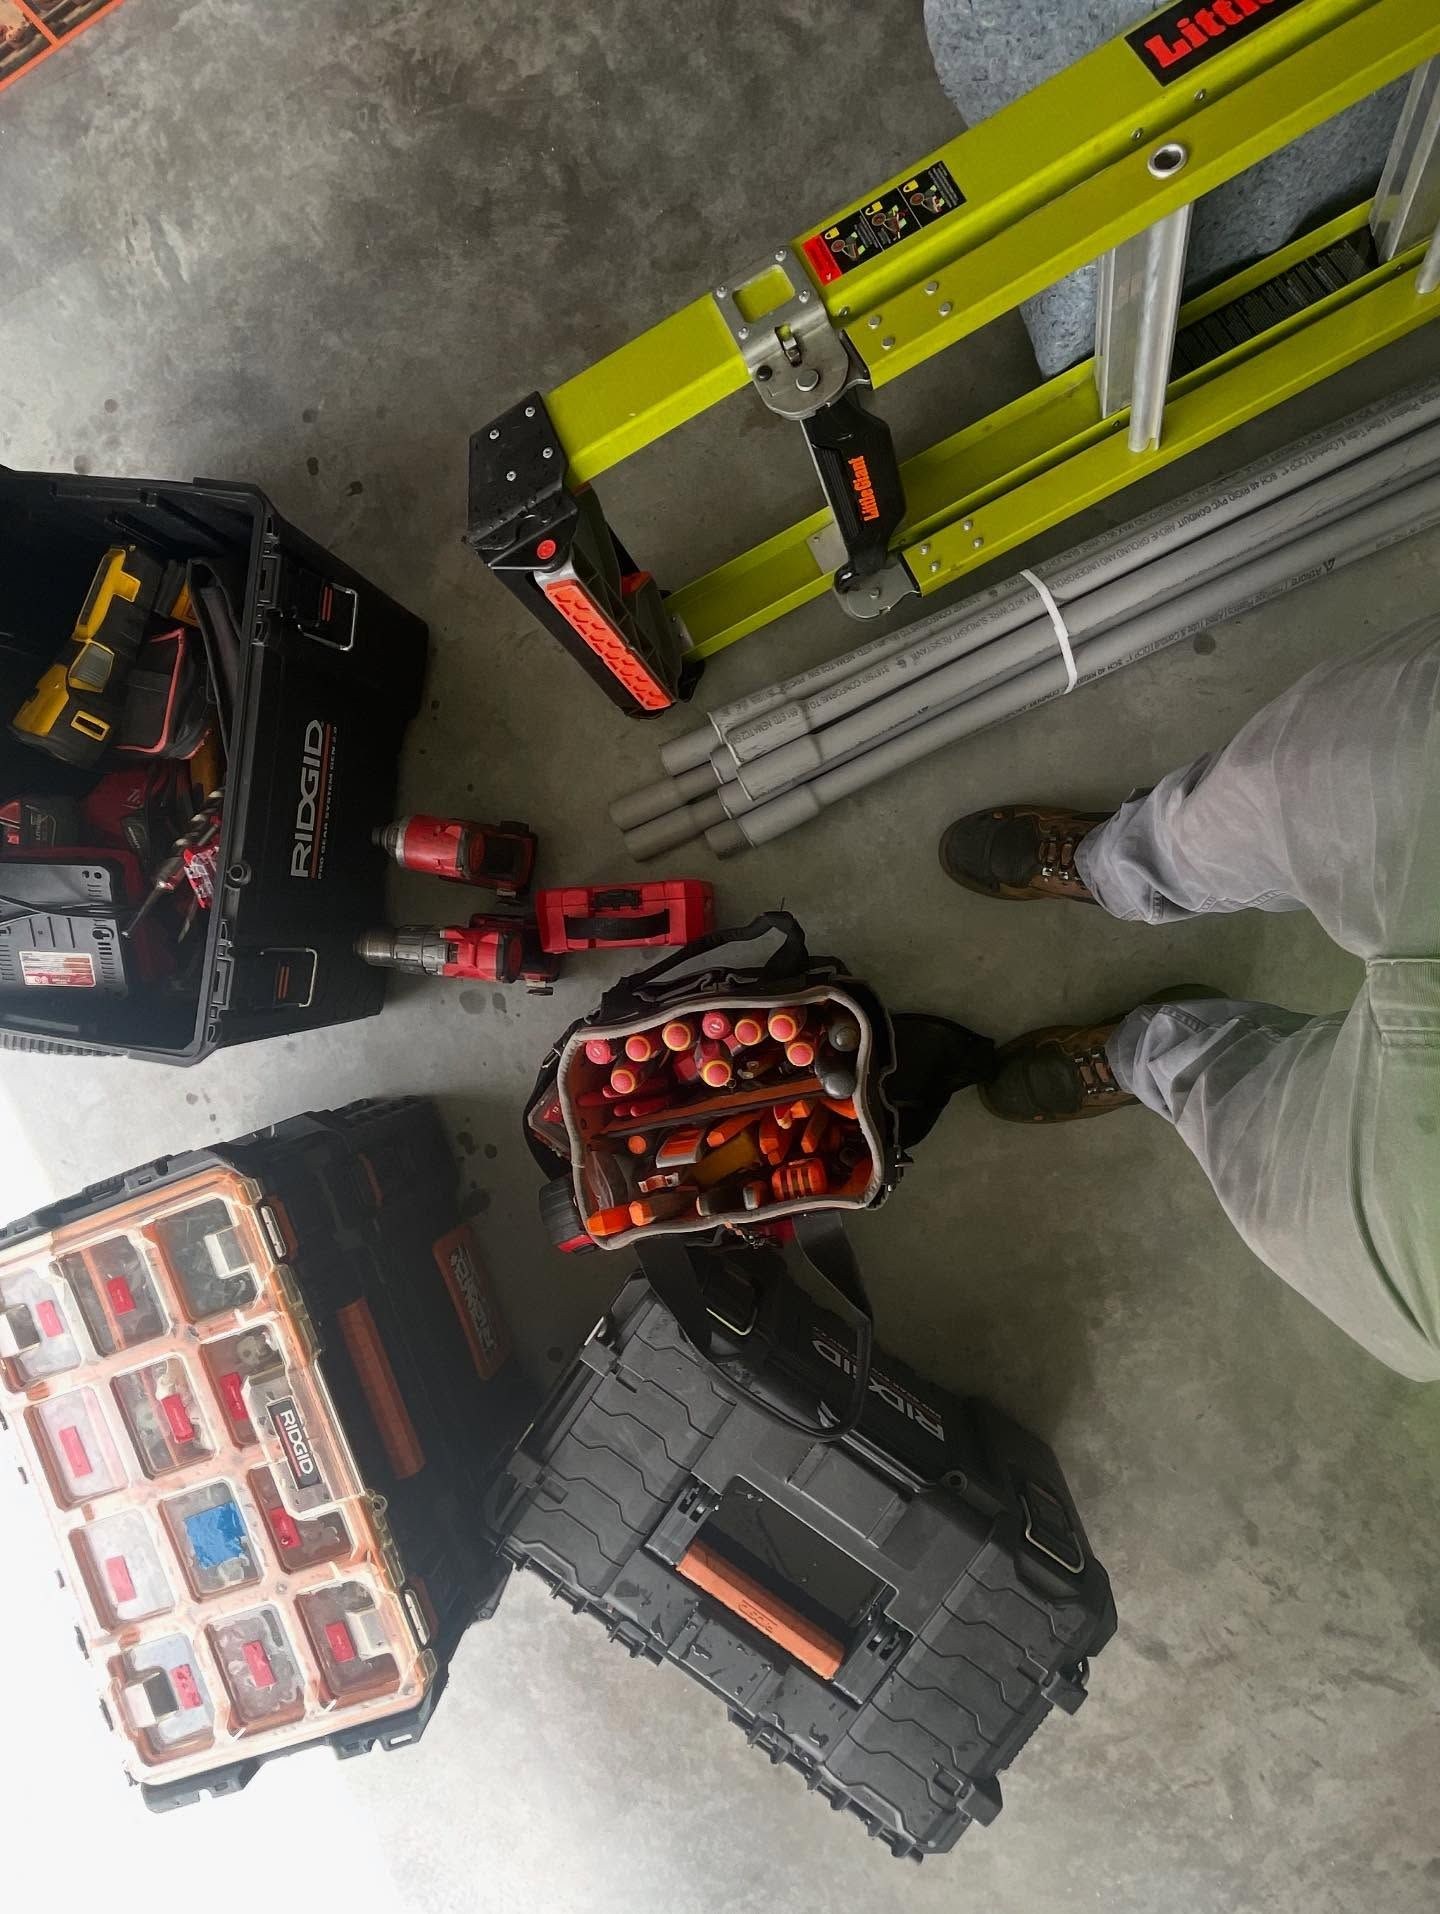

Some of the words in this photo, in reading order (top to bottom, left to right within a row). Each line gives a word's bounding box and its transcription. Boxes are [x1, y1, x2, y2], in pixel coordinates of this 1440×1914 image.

[848, 455, 872, 491] Giant
[1175, 505, 1211, 527] CONDUIT
[1210, 497, 1228, 510] PVC
[290, 719, 323, 877] RIDGID
[280, 1410, 314, 1475] RIDGID
